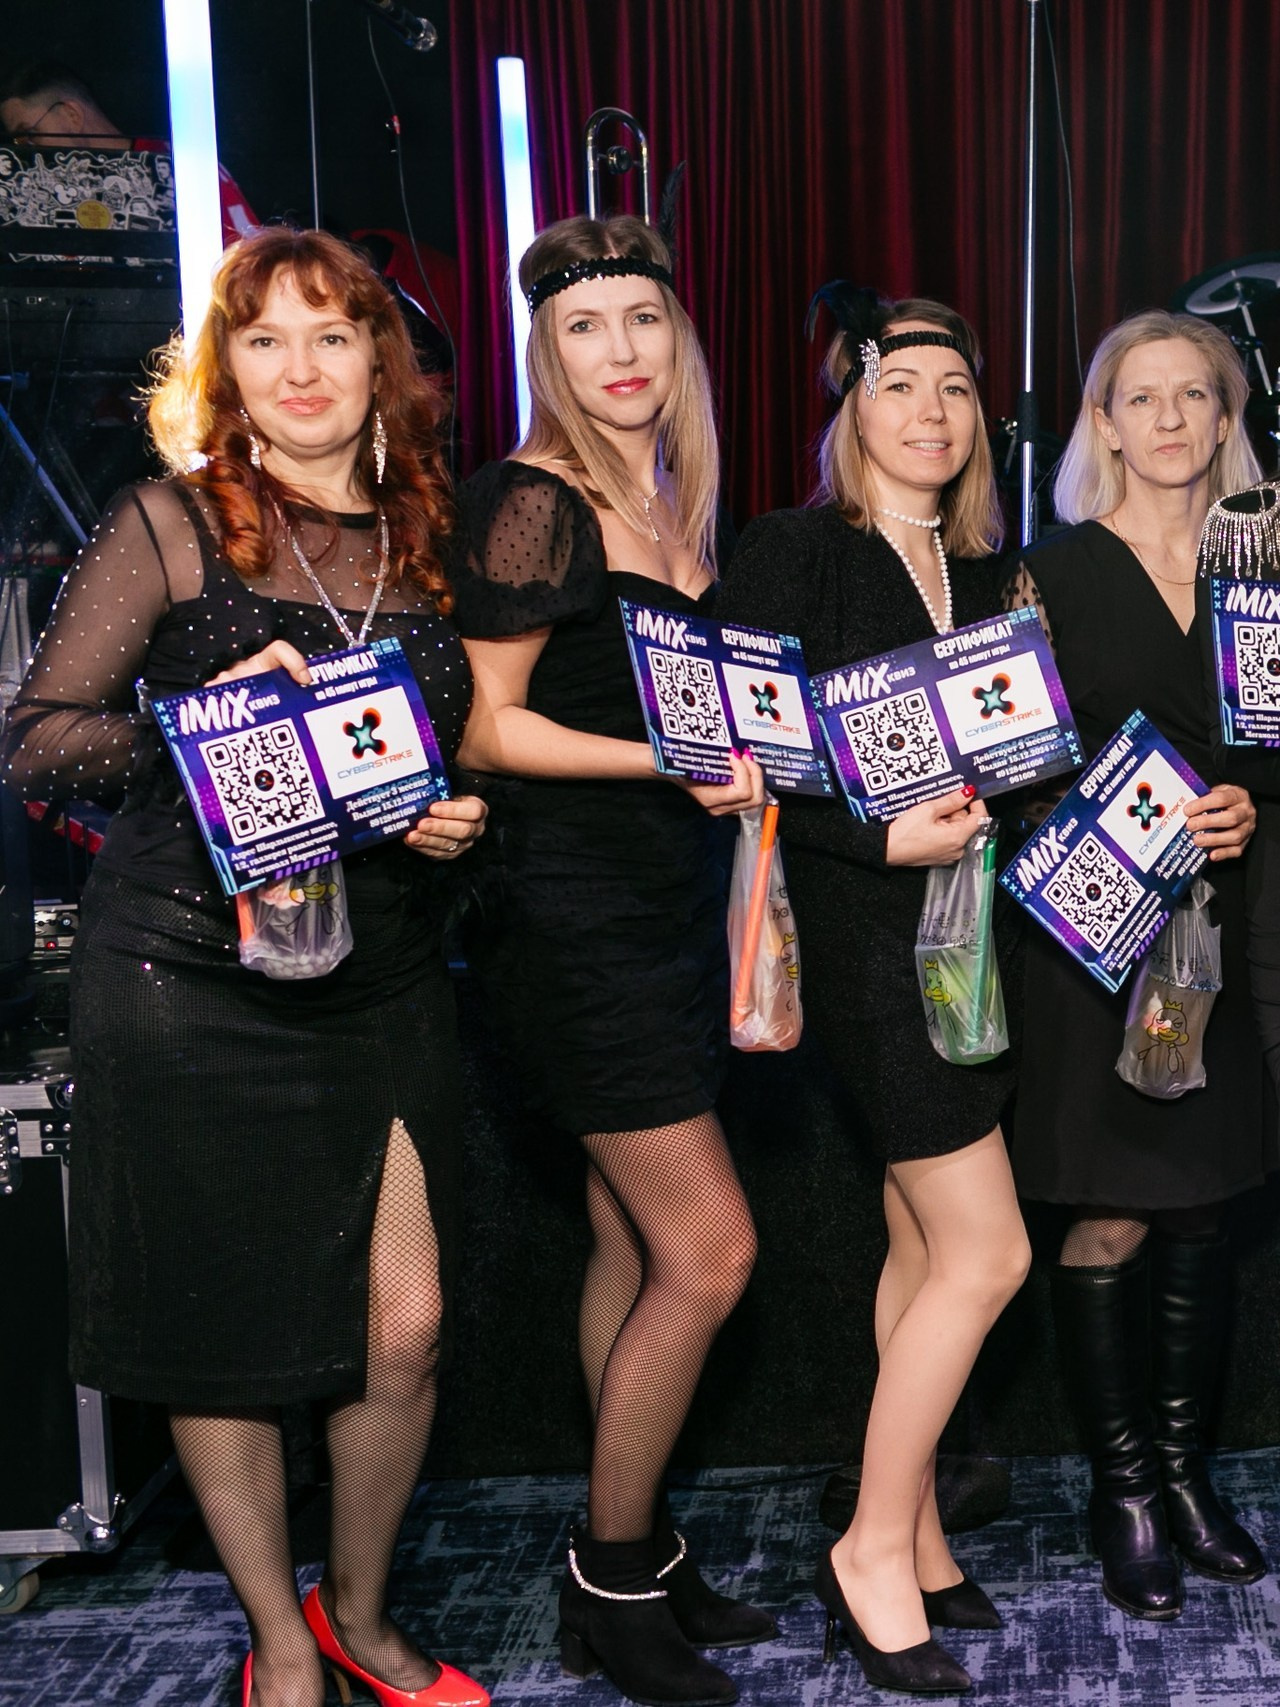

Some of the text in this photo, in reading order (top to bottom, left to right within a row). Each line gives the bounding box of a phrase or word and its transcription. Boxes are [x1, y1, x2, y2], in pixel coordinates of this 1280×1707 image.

[636, 610, 691, 651] IMIX
[721, 628, 782, 655] СЕРТИФИКАТ
[933, 620, 1013, 659] СЕРТИФИКАТ
[301, 650, 379, 687] РТИФИКАТ
[740, 651, 747, 661] 45
[765, 658, 779, 667] игры
[959, 656, 969, 666] 45
[991, 644, 1010, 656] игры
[325, 686, 336, 697] 45
[358, 676, 377, 688] игры
[827, 663, 895, 706] IMIX
[180, 687, 258, 735] IMIX
[965, 708, 1042, 737] CYBERSTRIKE
[1235, 713, 1255, 721] Адрес
[742, 718, 801, 735] CYBERSTRIKE
[337, 749, 413, 779] CYBERSTRIKE
[973, 734, 1058, 765] Действует 3 месяца
[978, 759, 1007, 772] Выдан
[1008, 745, 1050, 763] 15.12.2024
[1080, 732, 1132, 799] СЕРТИФИКАТ
[1104, 784, 1113, 796] 45
[1123, 754, 1137, 772] игры
[346, 779, 429, 812] Действует 3 месяца
[352, 806, 381, 821] Выдан
[382, 791, 422, 811] 15.12.2024
[865, 798, 887, 808] Адрес
[1139, 797, 1185, 855] CYBERSTRIKE
[230, 848, 255, 861] Адрес
[1017, 826, 1068, 891] IMIX
[1156, 840, 1183, 876] Действует
[1163, 857, 1182, 879] Выдан
[1099, 946, 1114, 965] Адрес
